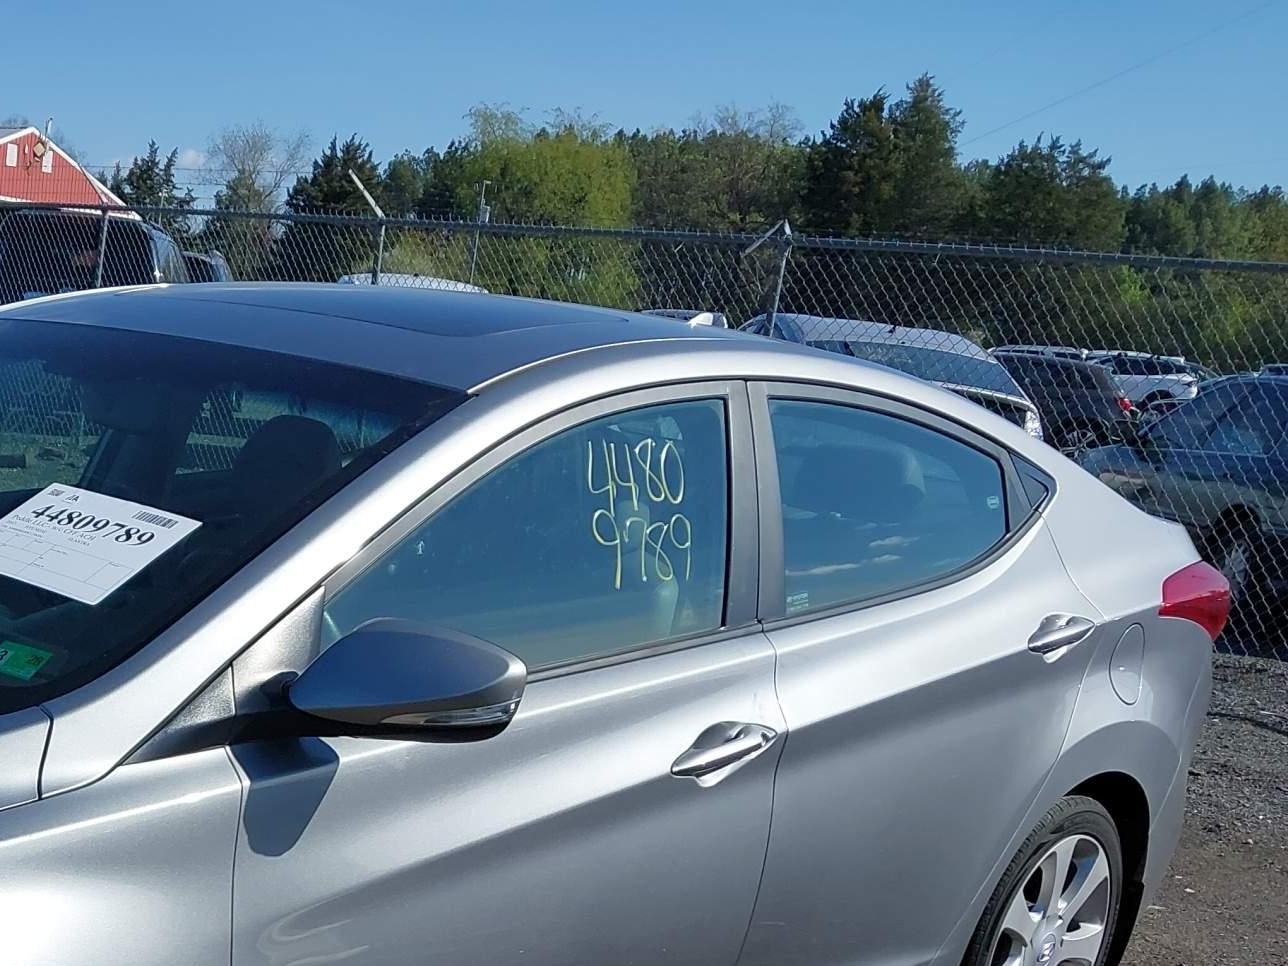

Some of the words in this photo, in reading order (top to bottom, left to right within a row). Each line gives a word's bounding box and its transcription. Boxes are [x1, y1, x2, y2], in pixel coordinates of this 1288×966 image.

[588, 438, 685, 518] 4480
[31, 504, 156, 547] 44809789
[592, 508, 692, 590] 9789
